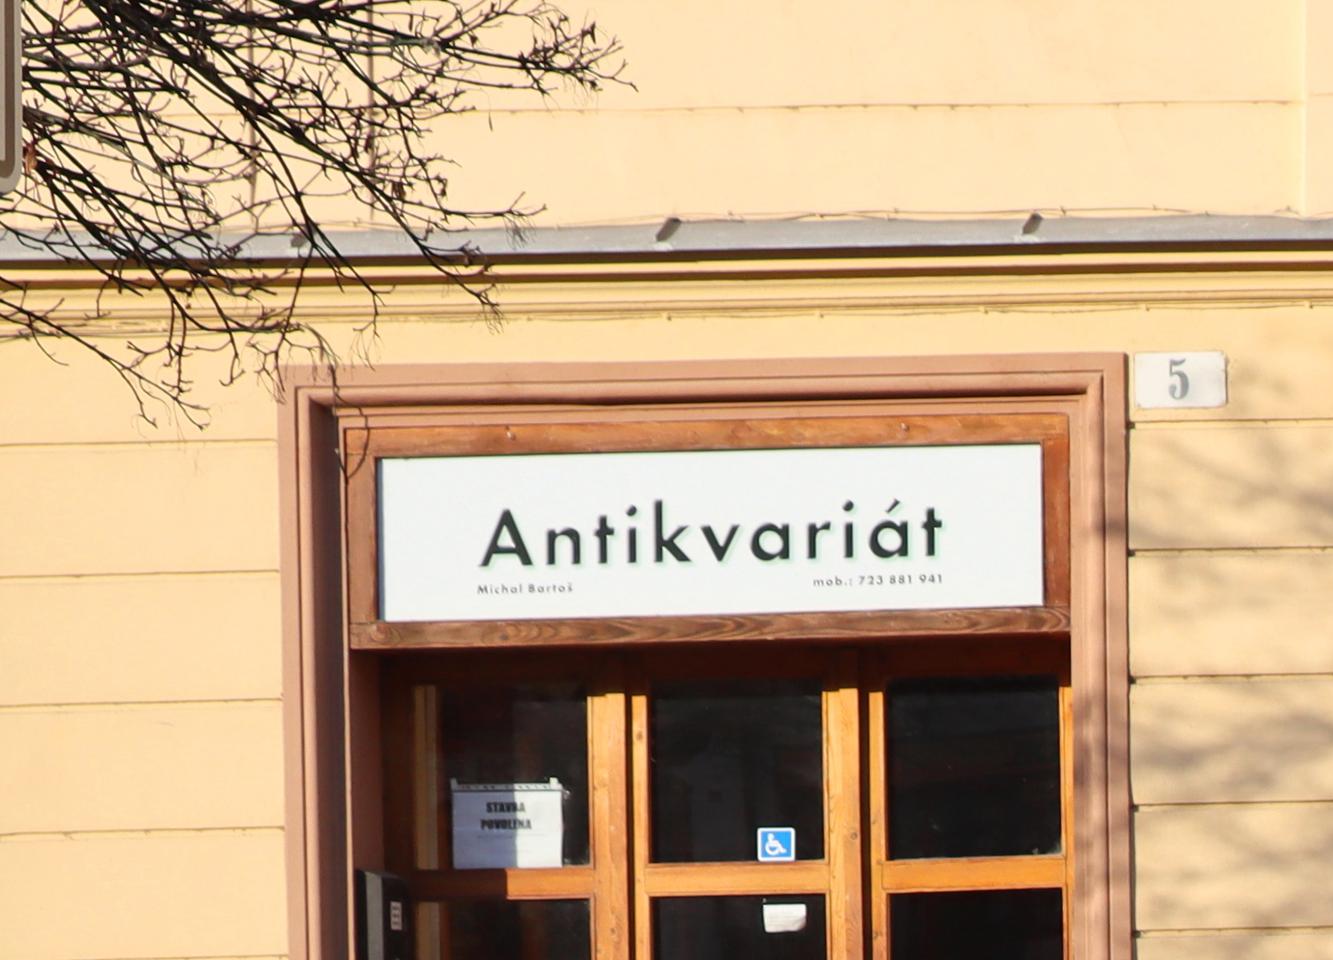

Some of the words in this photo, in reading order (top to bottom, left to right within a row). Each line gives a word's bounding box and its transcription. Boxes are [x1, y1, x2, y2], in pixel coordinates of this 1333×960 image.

[1168, 357, 1190, 400] 5
[480, 499, 943, 567] Antikvariát
[477, 583, 523, 595] Michal
[858, 575, 884, 586] 723
[889, 574, 913, 585] 881
[918, 573, 943, 584] 941
